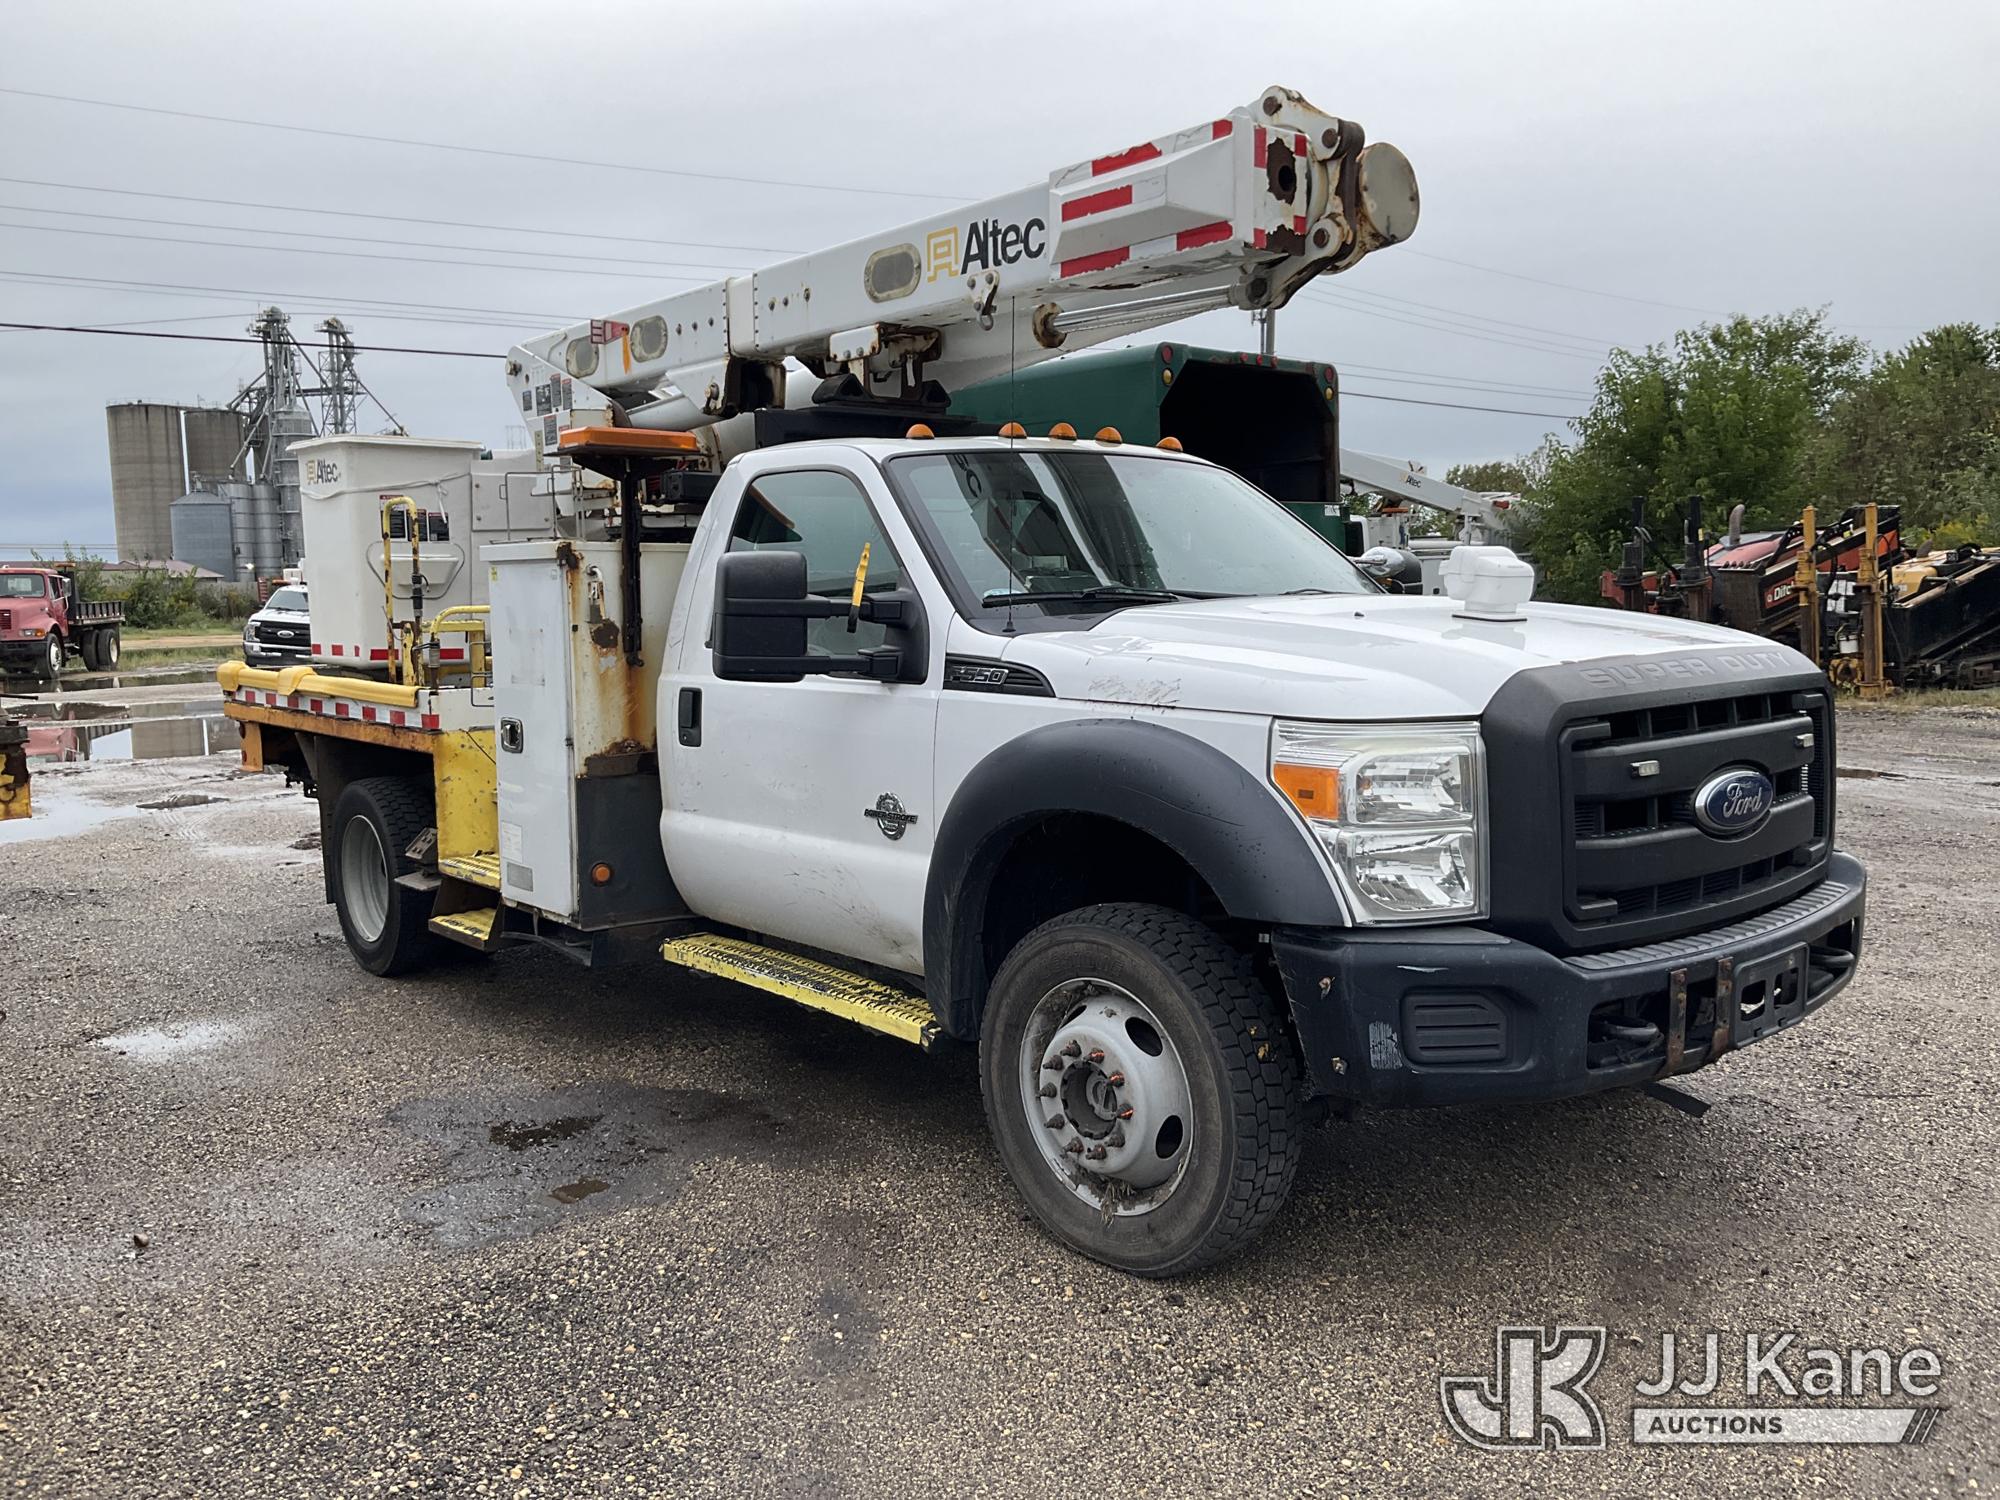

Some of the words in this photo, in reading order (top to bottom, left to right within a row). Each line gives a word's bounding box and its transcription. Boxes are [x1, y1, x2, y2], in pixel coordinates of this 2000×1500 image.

[960, 218, 1046, 275] Altec
[316, 458, 338, 484] Altec
[1578, 657, 1716, 690] SUPER
[1717, 651, 1791, 673] DUTY
[1722, 783, 1763, 818] Ford
